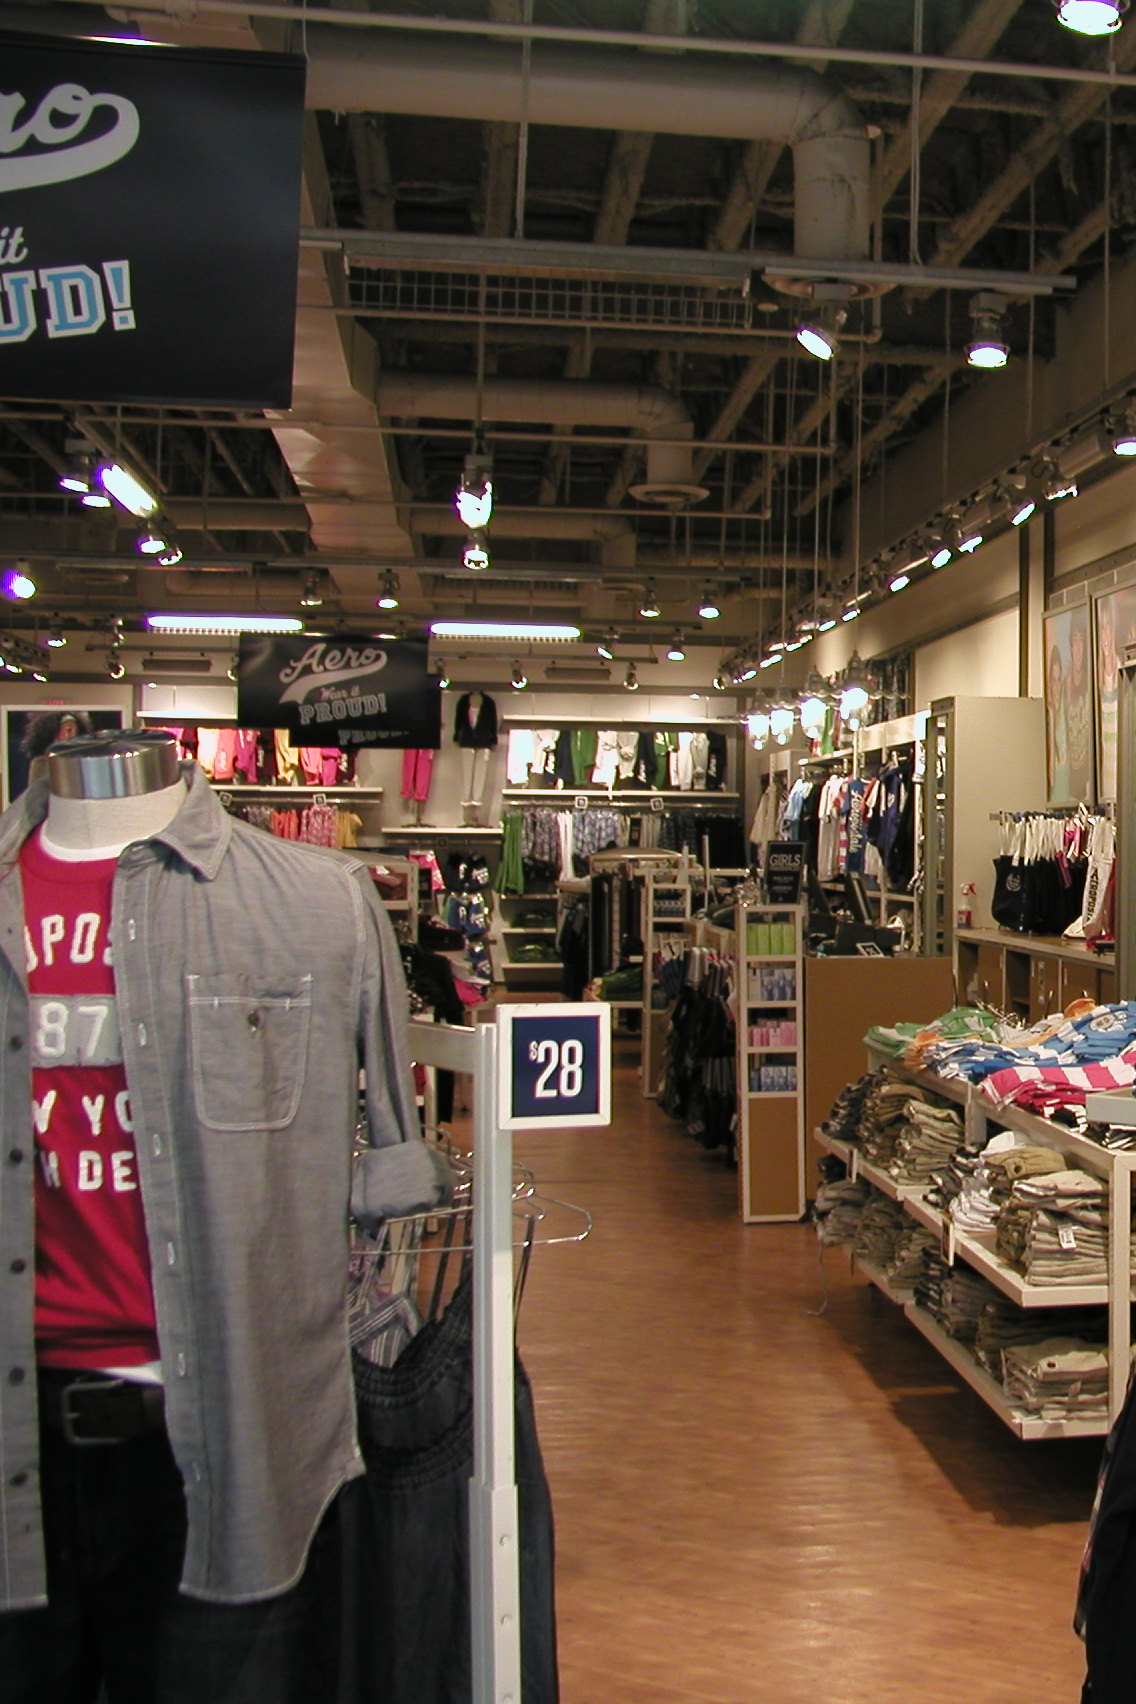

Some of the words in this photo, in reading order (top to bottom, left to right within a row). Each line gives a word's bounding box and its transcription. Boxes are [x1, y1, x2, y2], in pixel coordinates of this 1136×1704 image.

[279, 643, 388, 705] Aero
[299, 693, 388, 725] PROUD!
[769, 854, 801, 866] GIRLS
[36, 1002, 109, 1059] 87
[529, 1039, 584, 1098] $28
[78, 1151, 137, 1191] DE
